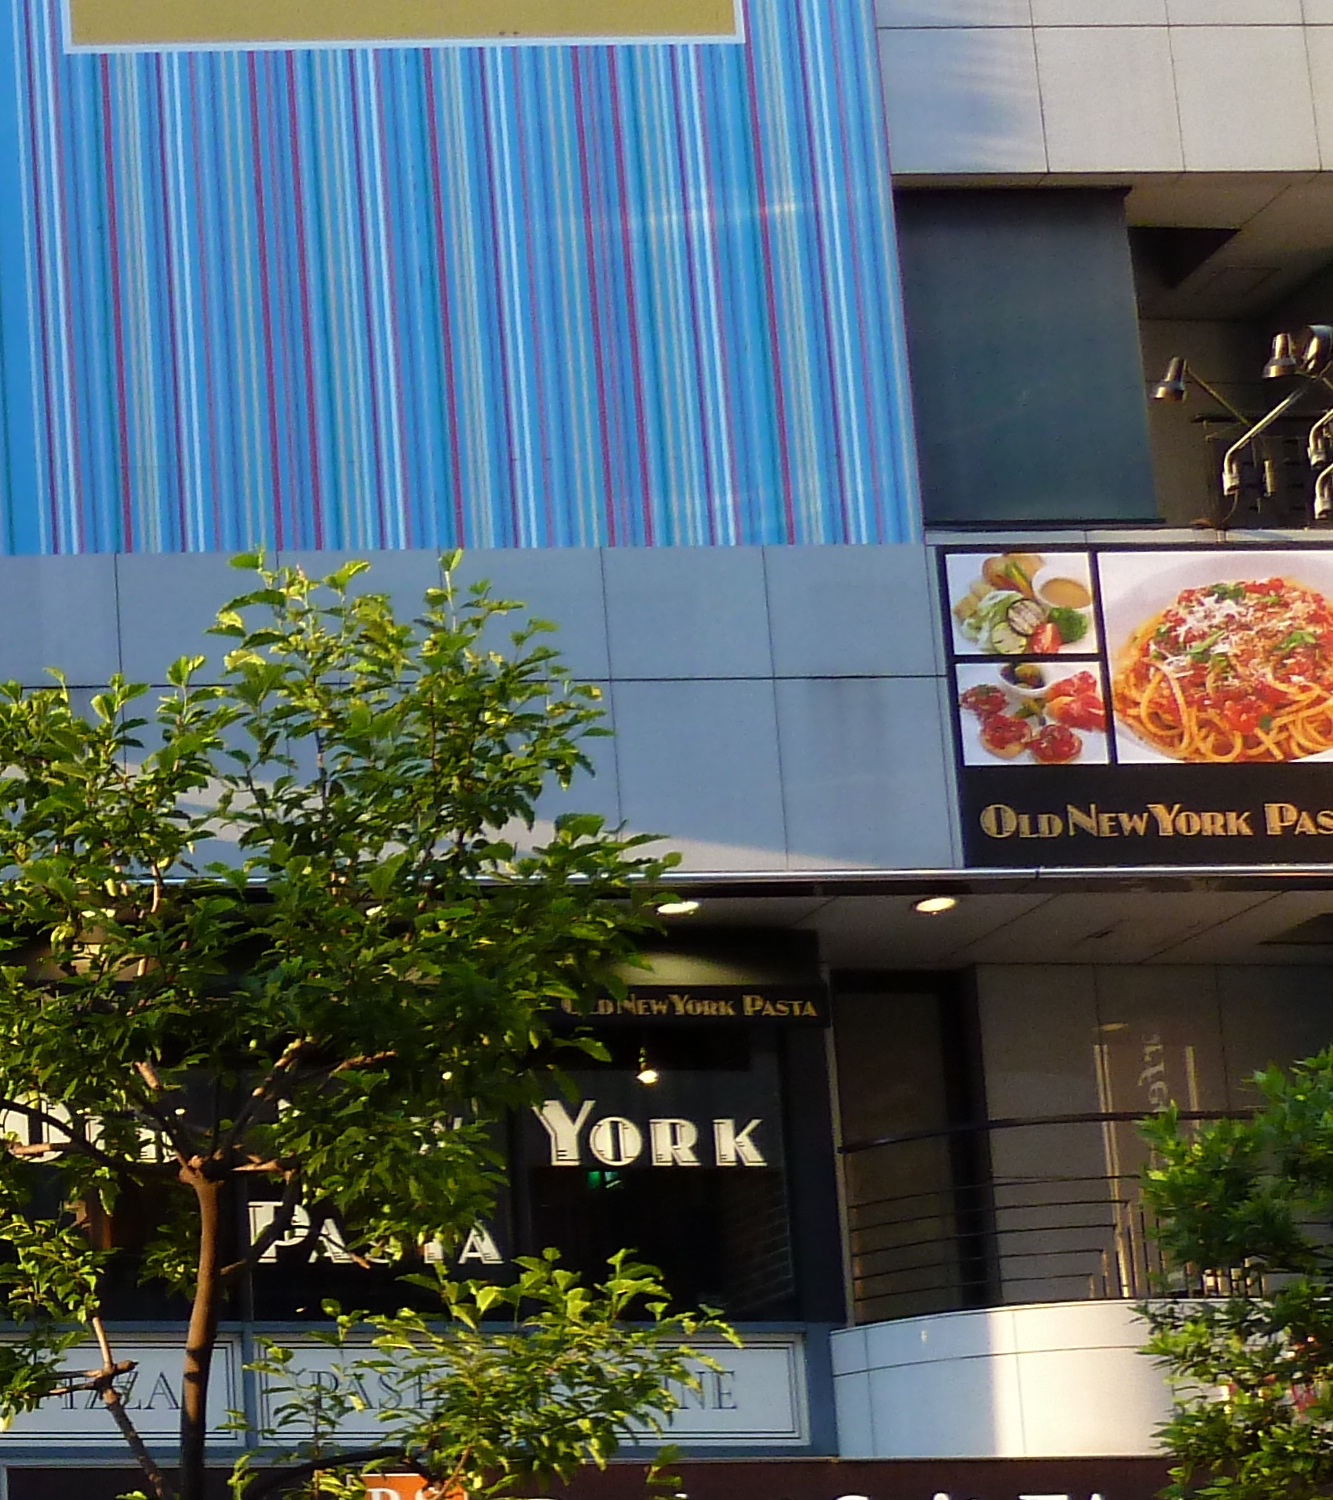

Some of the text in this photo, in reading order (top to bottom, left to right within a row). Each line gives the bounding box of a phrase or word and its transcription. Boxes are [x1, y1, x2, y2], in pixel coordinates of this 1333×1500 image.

[980, 804, 1063, 838] OLD
[1067, 804, 1147, 838] NEW
[1147, 803, 1253, 837] YORK
[668, 994, 735, 1016] YORK
[742, 994, 818, 1017] PASTA
[533, 1099, 767, 1168] YORK
[249, 1200, 505, 1265] PAA
[309, 1370, 430, 1410] PAST
